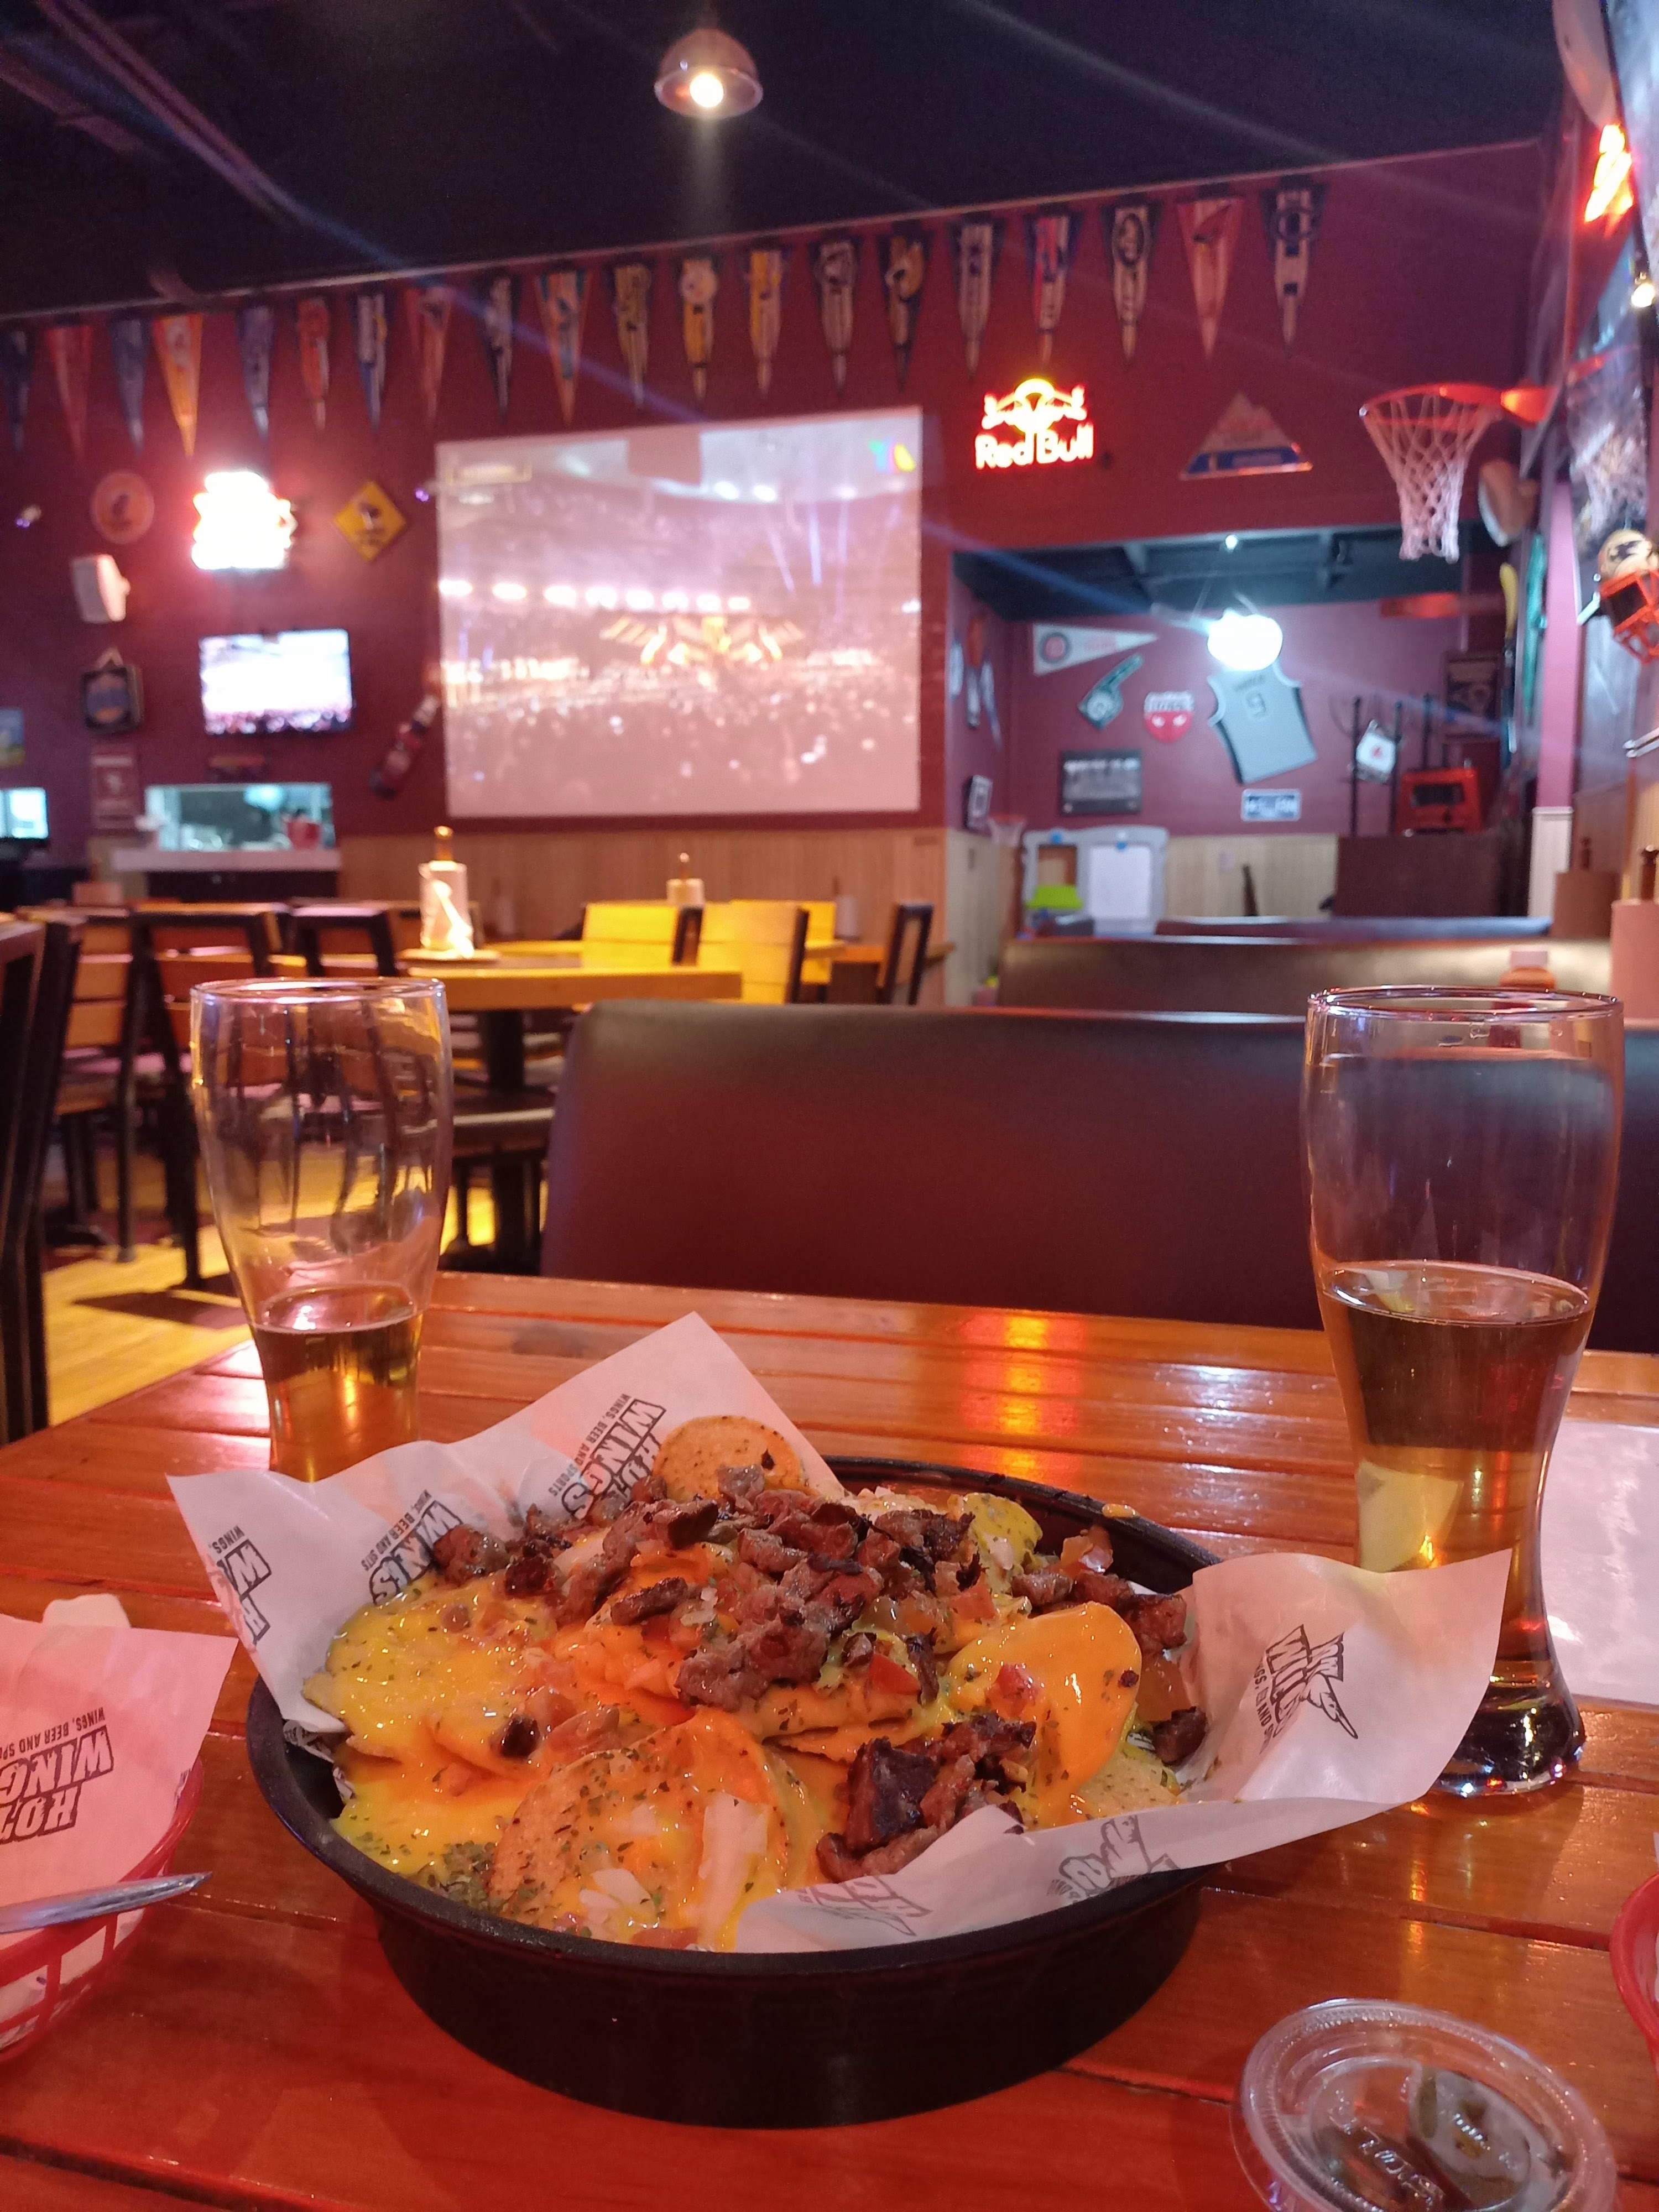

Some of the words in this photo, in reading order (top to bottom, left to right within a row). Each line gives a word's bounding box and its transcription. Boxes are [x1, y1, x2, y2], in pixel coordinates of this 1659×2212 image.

[975, 431, 1035, 470] Red
[1035, 422, 1094, 465] Bull
[585, 1420, 608, 1444] BEER
[561, 1398, 667, 1520] WINGS
[573, 1442, 591, 1466] AND
[548, 1463, 579, 1496] SPORTS
[1256, 1702, 1272, 1727] AND
[19, 1732, 41, 1754] AND
[44, 1721, 69, 1745] BEER
